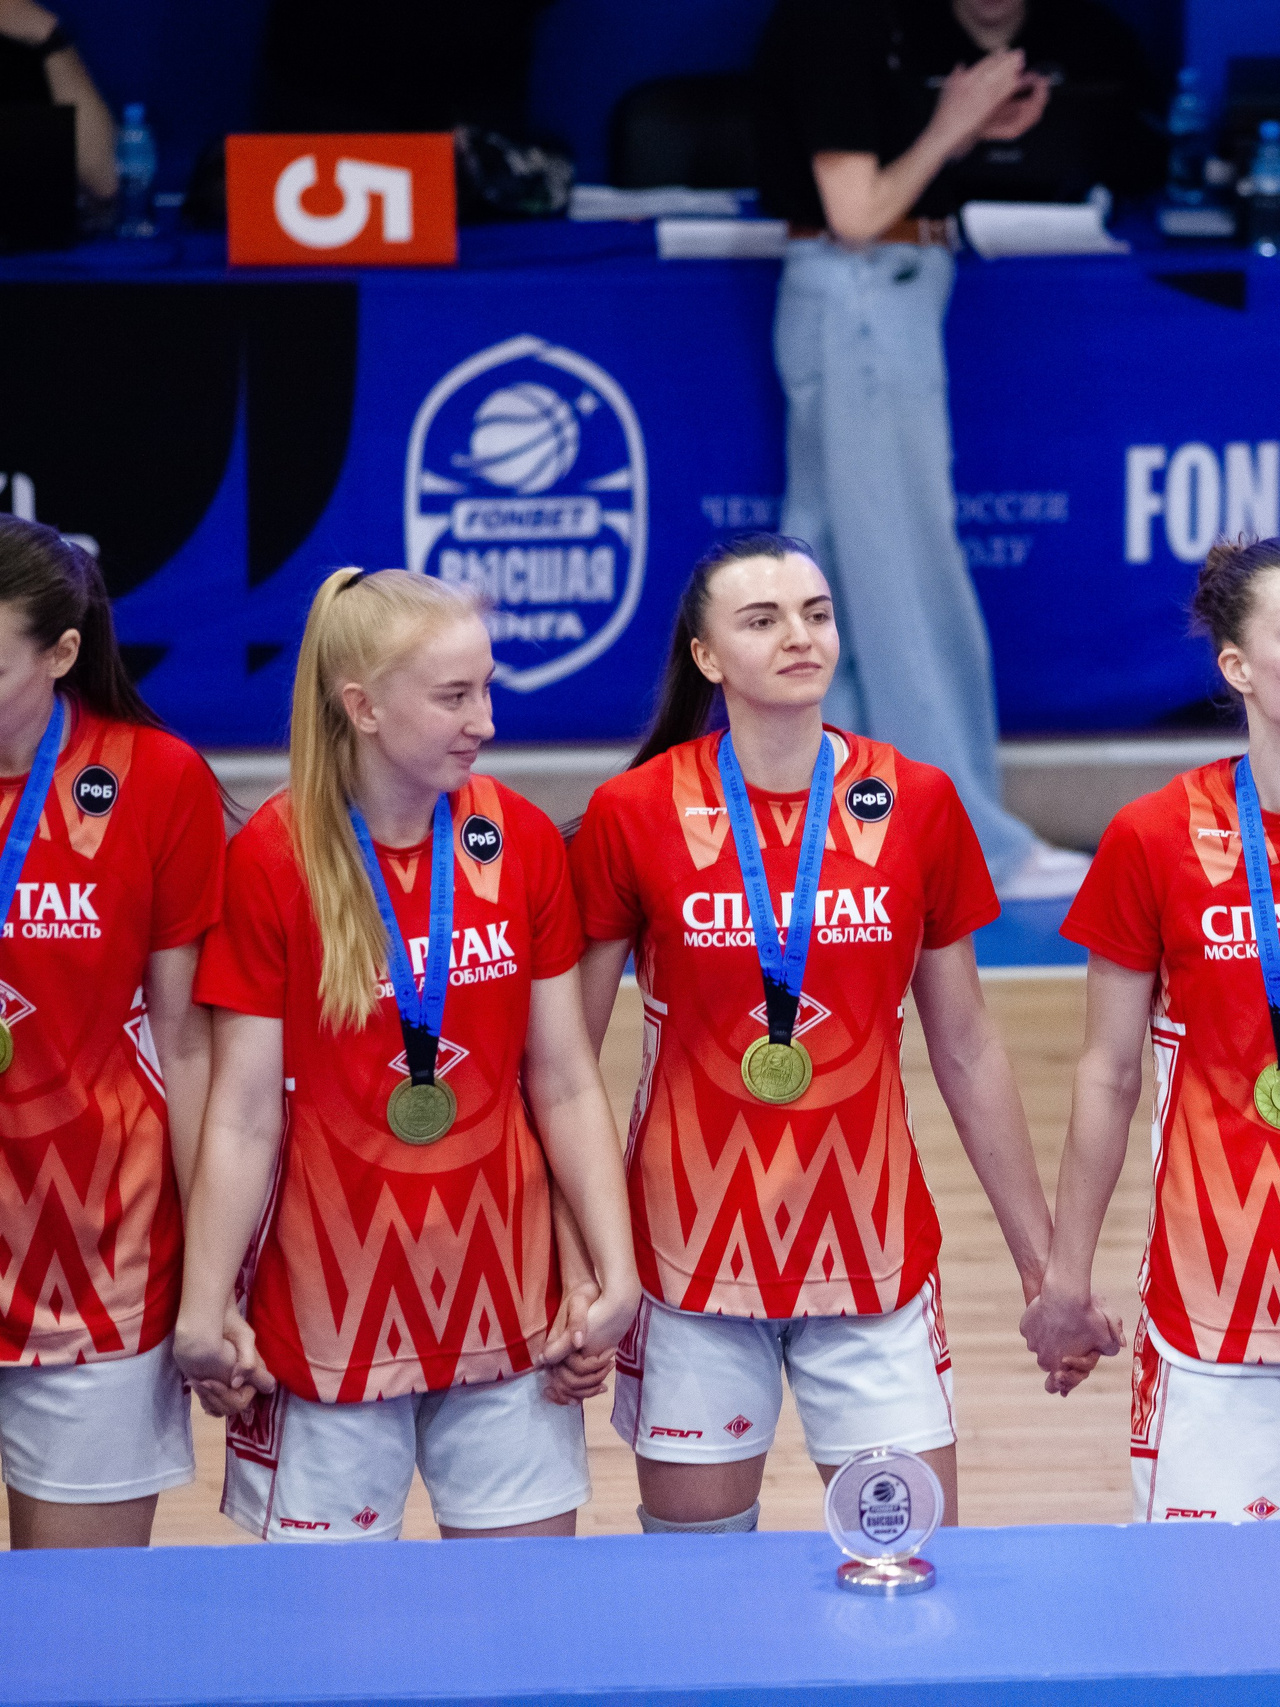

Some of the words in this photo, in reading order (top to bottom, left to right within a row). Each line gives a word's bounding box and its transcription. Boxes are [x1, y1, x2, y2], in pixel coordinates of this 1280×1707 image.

[273, 155, 413, 249] 5
[80, 783, 113, 799] РФБ
[853, 792, 887, 806] РФБ
[468, 831, 496, 847] РФБ
[682, 886, 892, 931] СПТАК
[21, 922, 102, 939] ОБЛАСТЬ
[817, 926, 893, 944] ОБЛАСТЬ
[449, 960, 518, 987] ОБЛАСТЬ
